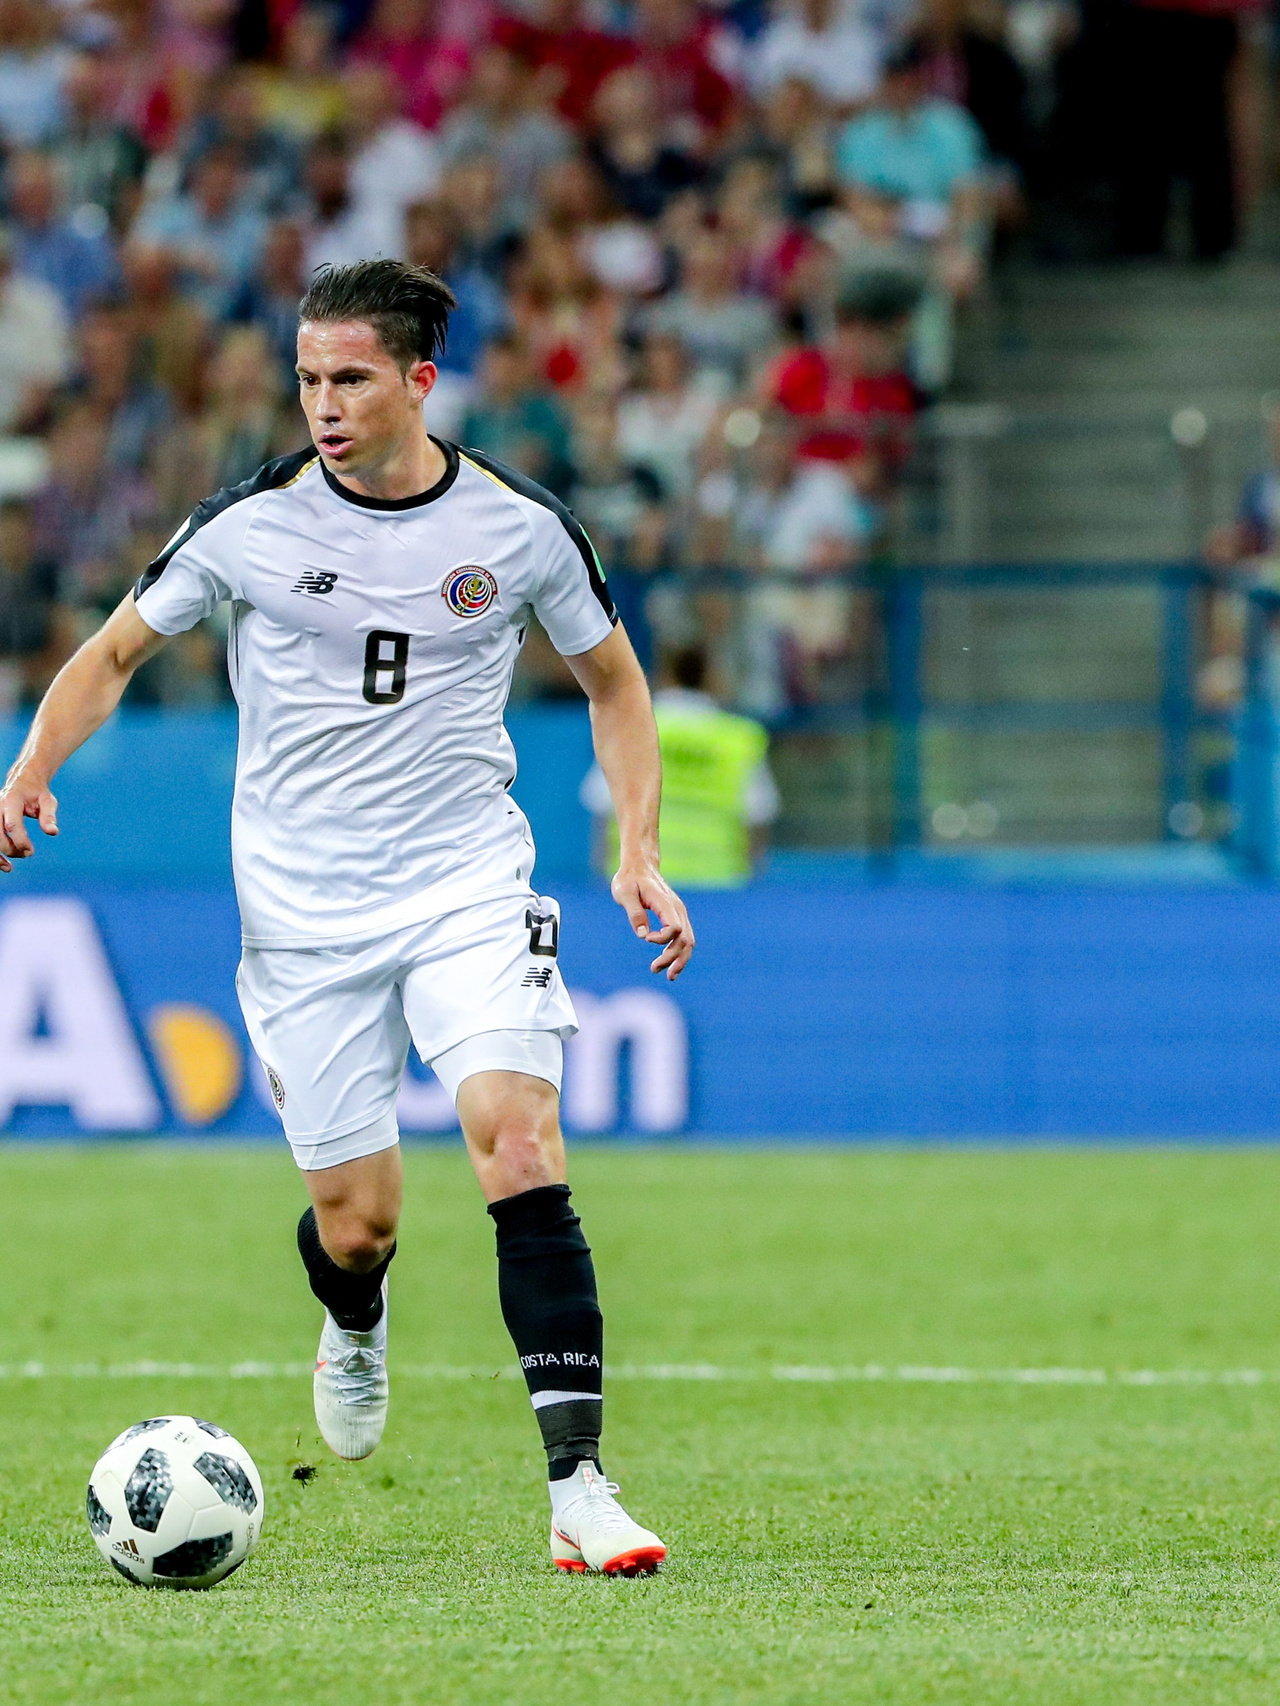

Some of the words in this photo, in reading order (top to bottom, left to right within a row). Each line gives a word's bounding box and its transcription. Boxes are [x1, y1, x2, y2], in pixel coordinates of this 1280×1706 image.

[362, 629, 410, 705] 8
[521, 1353, 559, 1369] COSTA
[563, 1352, 600, 1368] RICA
[111, 1543, 145, 1564] adidas
